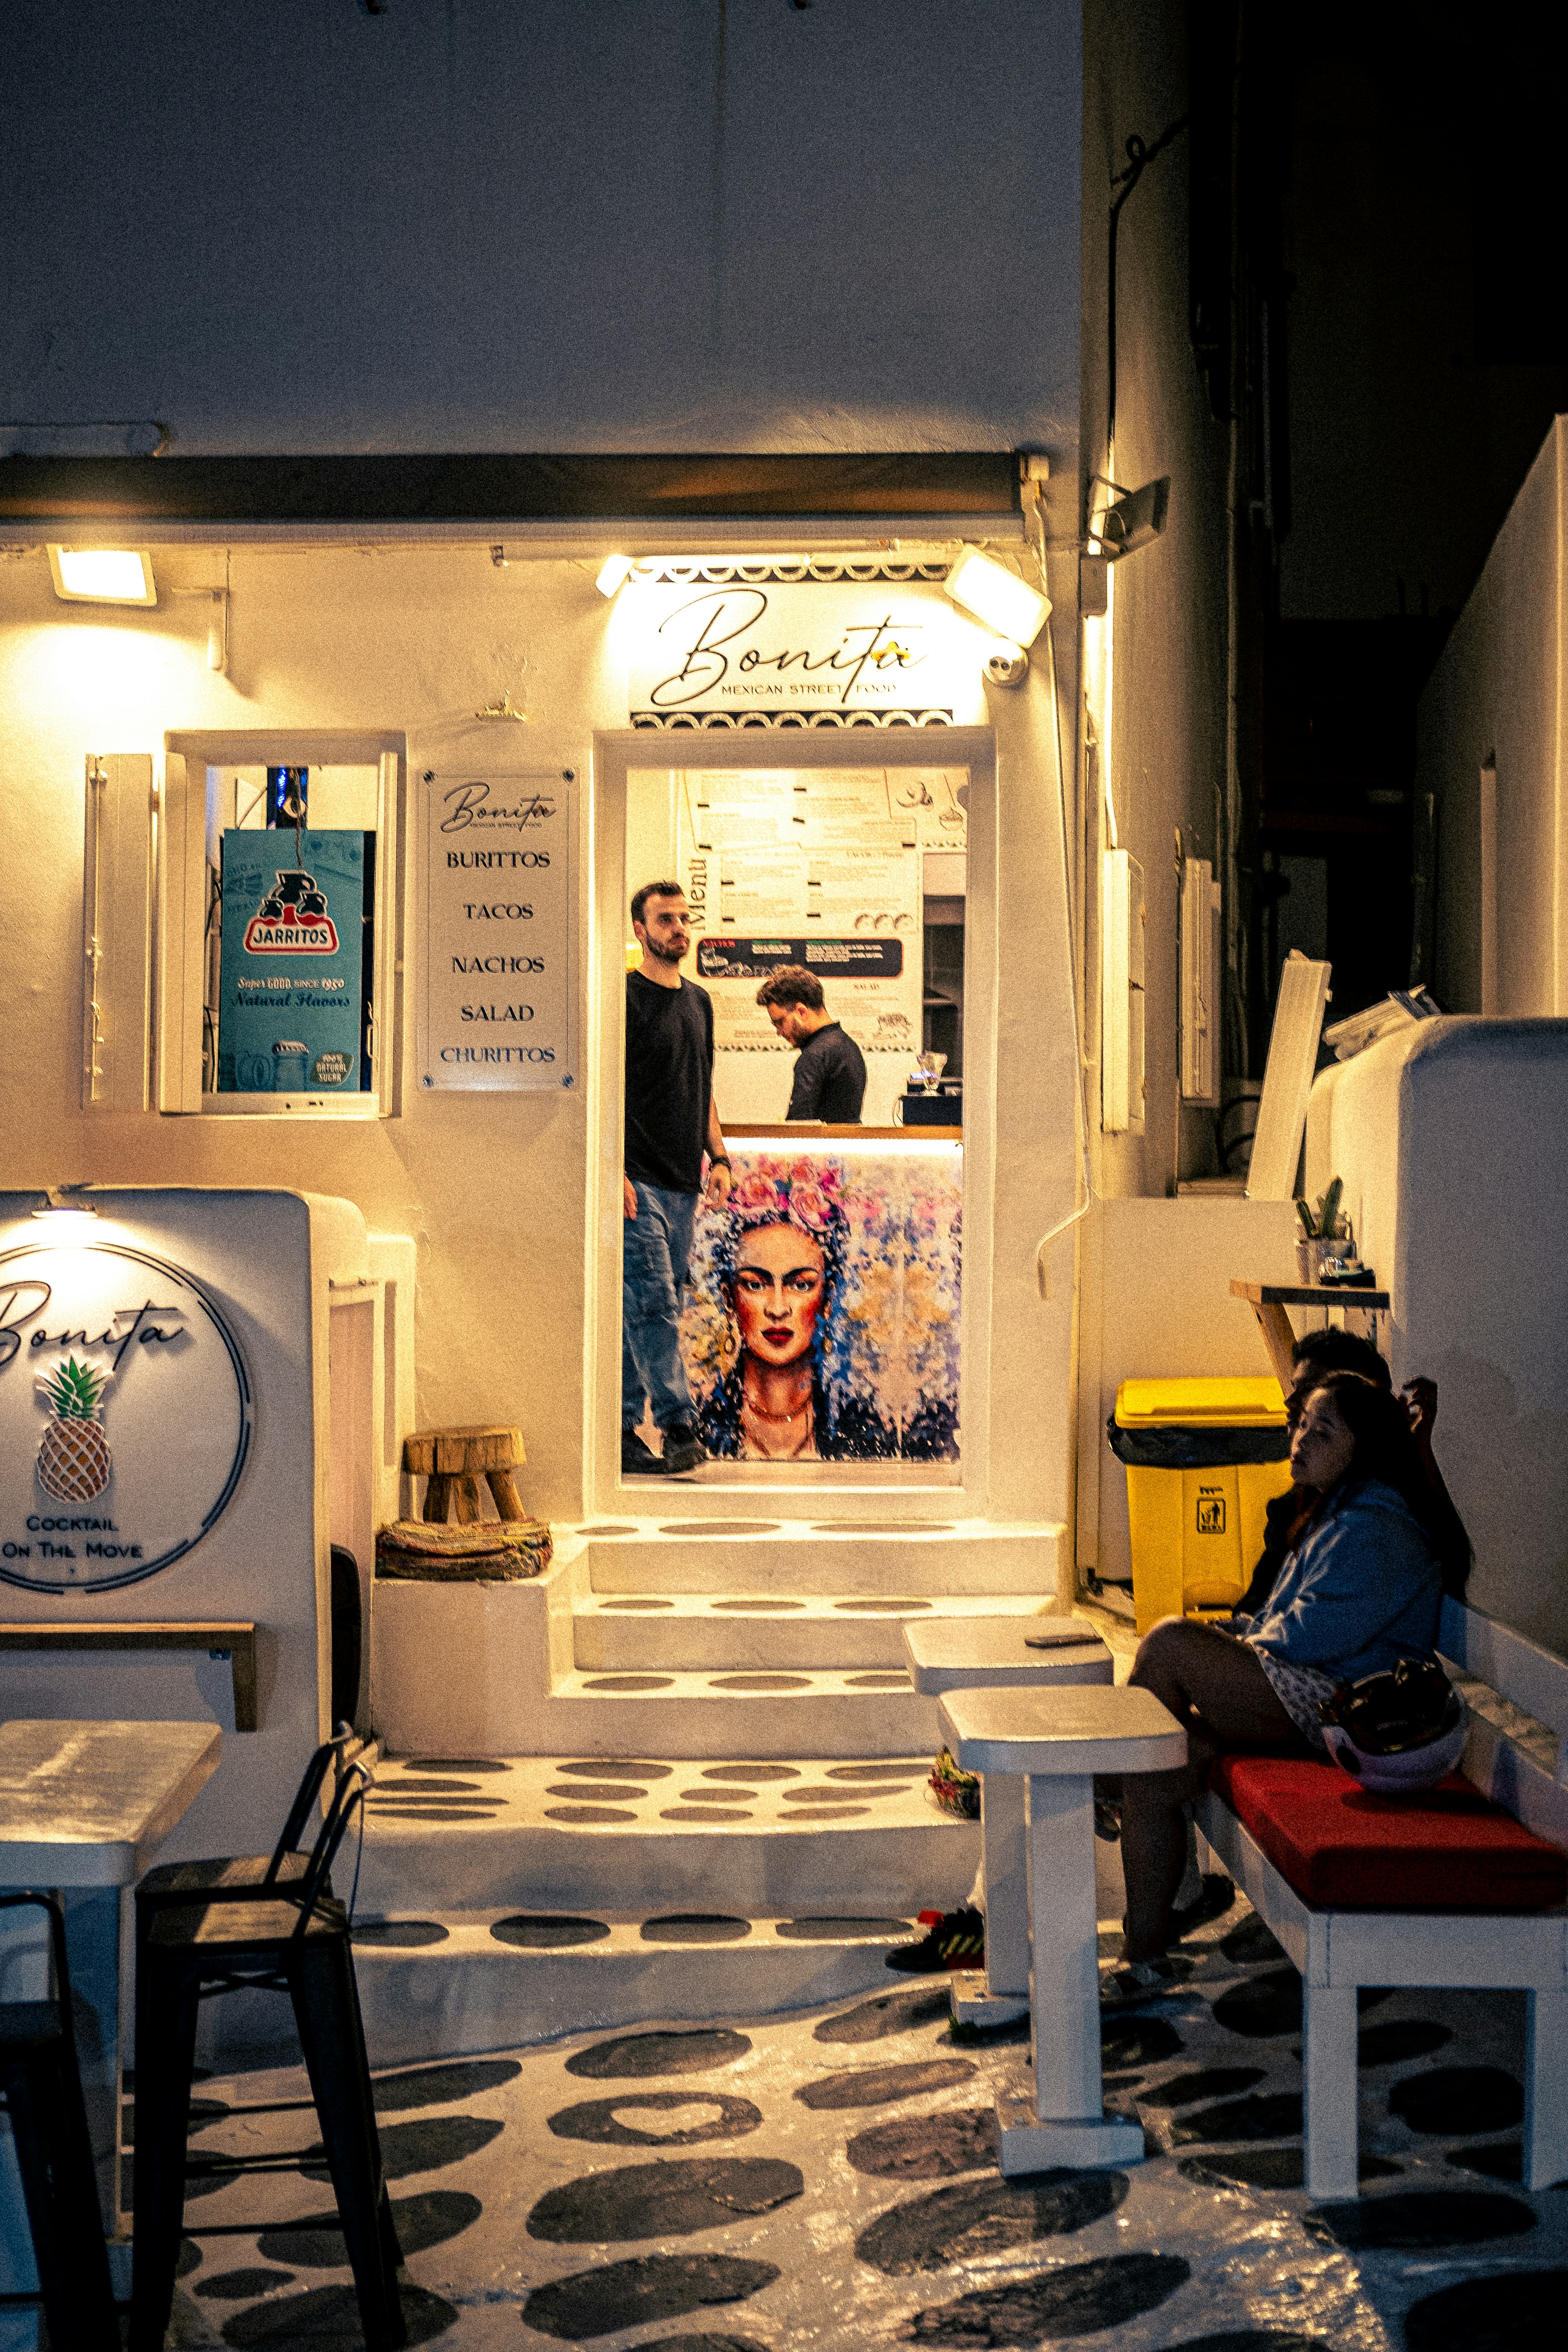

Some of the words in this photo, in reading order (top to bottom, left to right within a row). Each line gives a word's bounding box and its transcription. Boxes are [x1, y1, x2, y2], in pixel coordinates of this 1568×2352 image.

[650, 588, 928, 706] Bonita
[722, 684, 782, 695] MEXICAN
[790, 684, 842, 694] STREET
[856, 684, 897, 694] FOOD
[440, 781, 557, 833] Bonita
[446, 851, 550, 869] BURITTOS
[689, 858, 707, 931] Menu
[463, 903, 533, 920] TACOS
[252, 927, 328, 945] JARRITOS
[452, 956, 545, 974] NACHOS
[237, 976, 266, 991] Super
[294, 979, 320, 989] SINCE
[231, 992, 292, 1007] Natural
[295, 992, 351, 1007] Flavors
[460, 1005, 534, 1022] SALAD
[441, 1046, 555, 1064] CHURITTOS
[316, 1062, 347, 1073] NATURAL
[319, 1073, 342, 1082] SUGAR
[0, 1280, 183, 1371] Bonita
[26, 1515, 118, 1533] COCKTAIL
[2, 1542, 30, 1559] ON
[38, 1541, 76, 1559] THE
[85, 1541, 143, 1559] MOVE
